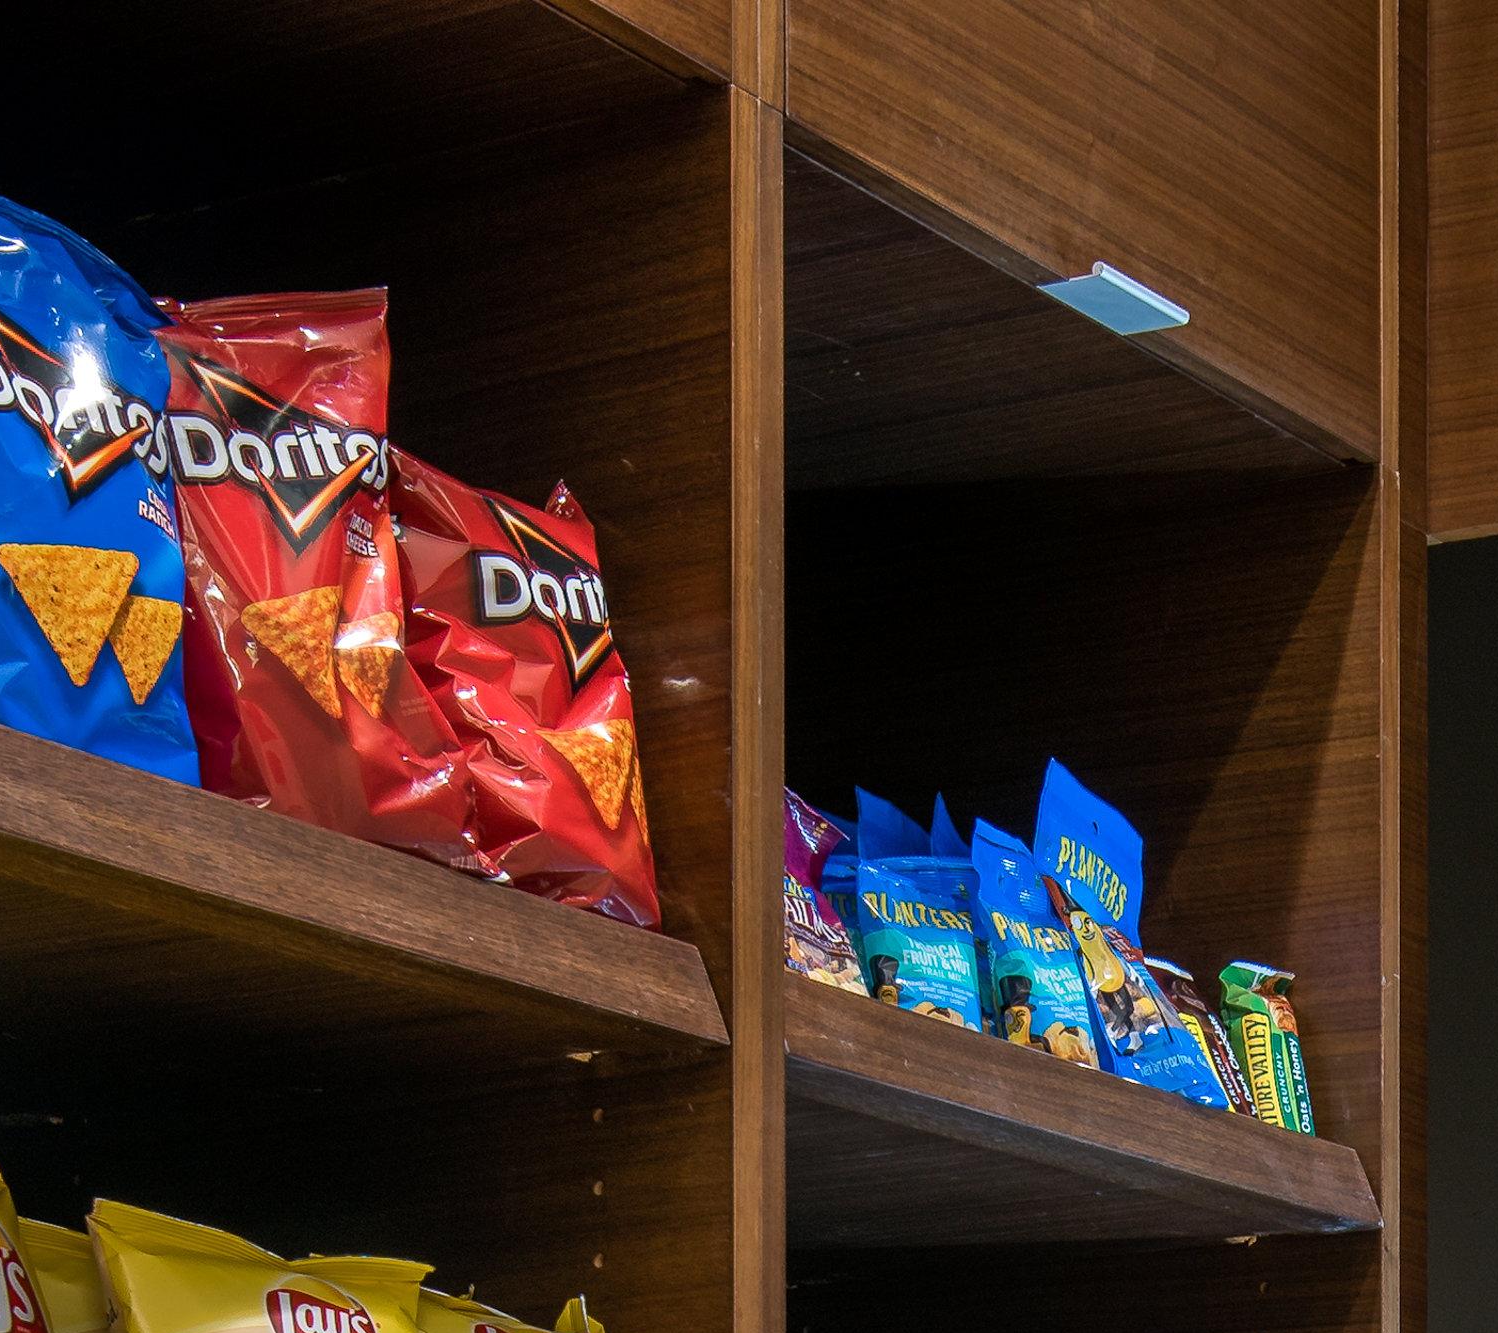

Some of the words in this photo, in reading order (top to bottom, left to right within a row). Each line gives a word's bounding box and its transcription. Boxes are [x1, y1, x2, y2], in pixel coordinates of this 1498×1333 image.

[169, 413, 389, 490] Doritos
[478, 553, 608, 625] Dorit
[1056, 835, 1128, 922] PLANTERS
[1244, 1018, 1269, 1080] VALLEY
[1288, 1036, 1302, 1081] Honey
[1275, 1052, 1291, 1114] CRUNCHY
[1300, 1101, 1313, 1134] Oats
